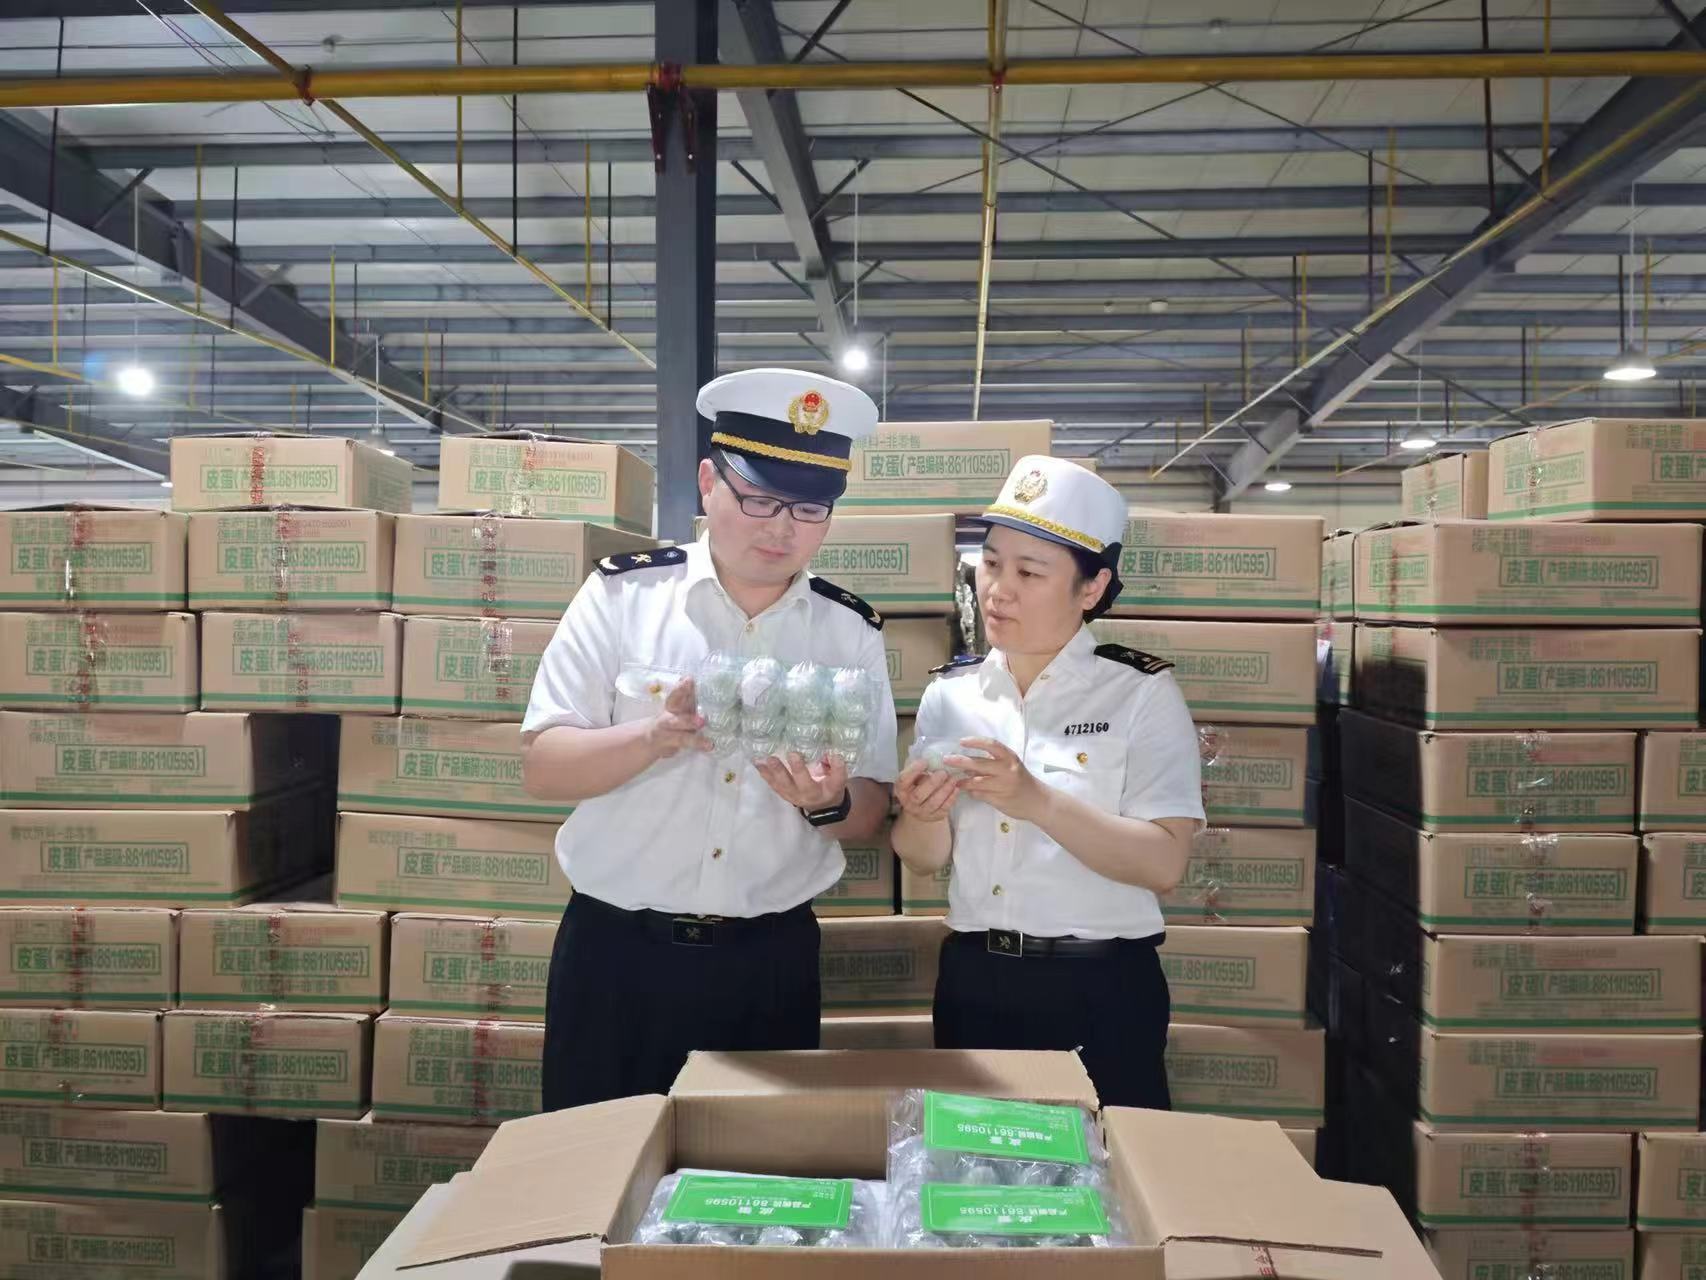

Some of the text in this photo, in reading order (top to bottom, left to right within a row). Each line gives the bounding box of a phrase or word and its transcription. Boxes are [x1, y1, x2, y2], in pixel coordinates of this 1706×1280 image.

[871, 453, 1004, 477] 皮蛋(产品编码:86110595)
[206, 469, 334, 492] 皮蛋(产码:86110595)
[474, 472, 602, 497] 皮蛋(码:86110595)
[430, 552, 568, 578] 皮蛋(产码:86110595)
[1122, 550, 1270, 576] 皮蛋(产品编码:86110595)
[33, 649, 167, 674] 皮蛋(产码:86110595)
[1064, 722, 1109, 736] 4712160
[61, 748, 199, 773] 皮蛋(产品编码:86110595)
[404, 853, 544, 881] 皮蛋(产品编码:86110595)
